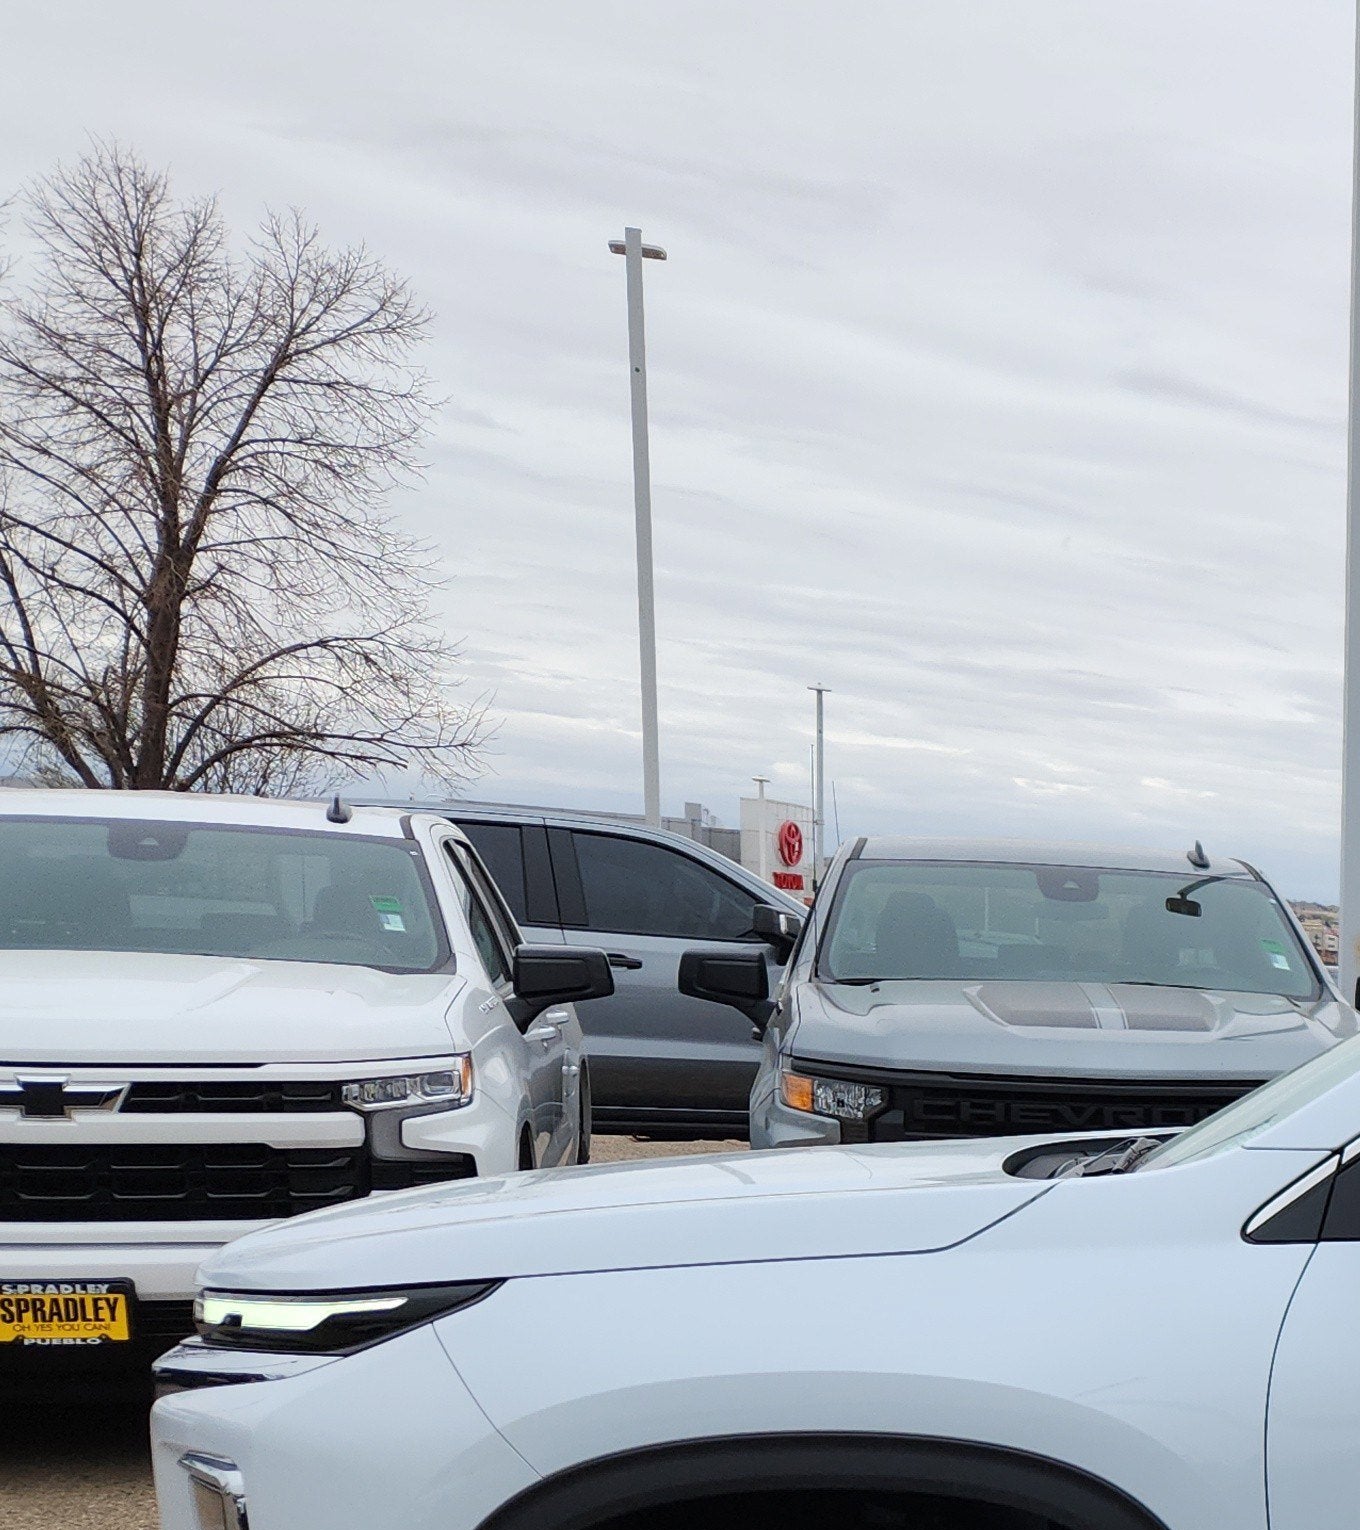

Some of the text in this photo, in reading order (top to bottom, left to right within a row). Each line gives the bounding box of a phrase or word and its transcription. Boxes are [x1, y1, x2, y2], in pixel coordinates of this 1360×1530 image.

[1, 1284, 110, 1295] SPRADLEY
[0, 1297, 119, 1324] SPRADLEY
[13, 1323, 30, 1332] OH
[36, 1323, 53, 1332] YES
[57, 1323, 80, 1332] YOU
[23, 1338, 102, 1346] PUEBLO
